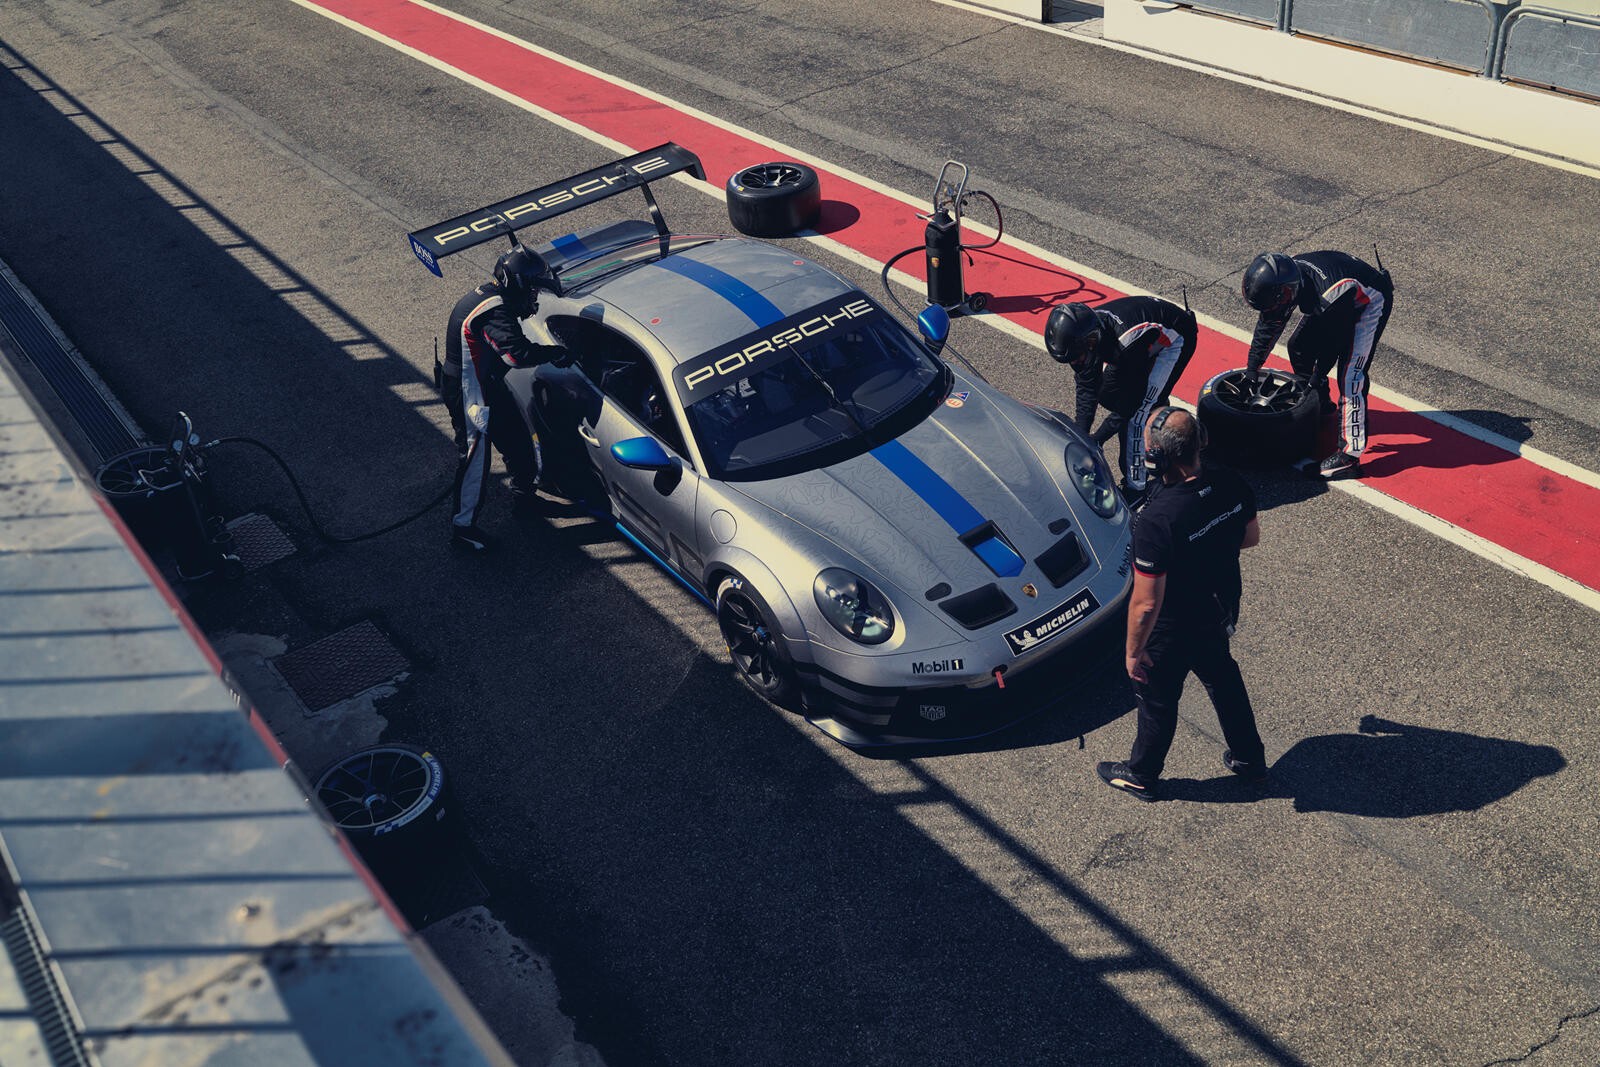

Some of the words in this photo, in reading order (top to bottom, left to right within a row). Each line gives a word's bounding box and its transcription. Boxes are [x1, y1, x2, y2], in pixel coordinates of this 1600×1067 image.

[434, 156, 669, 246] PORSCHE
[684, 299, 874, 391] PORSCHE
[1133, 386, 1158, 480] PORSCHE
[1352, 356, 1365, 451] PORSCHE
[1189, 503, 1242, 541] PORSCHE
[1035, 599, 1089, 637] MICHELIN
[912, 660, 949, 674] Mobil
[952, 659, 961, 670] 1
